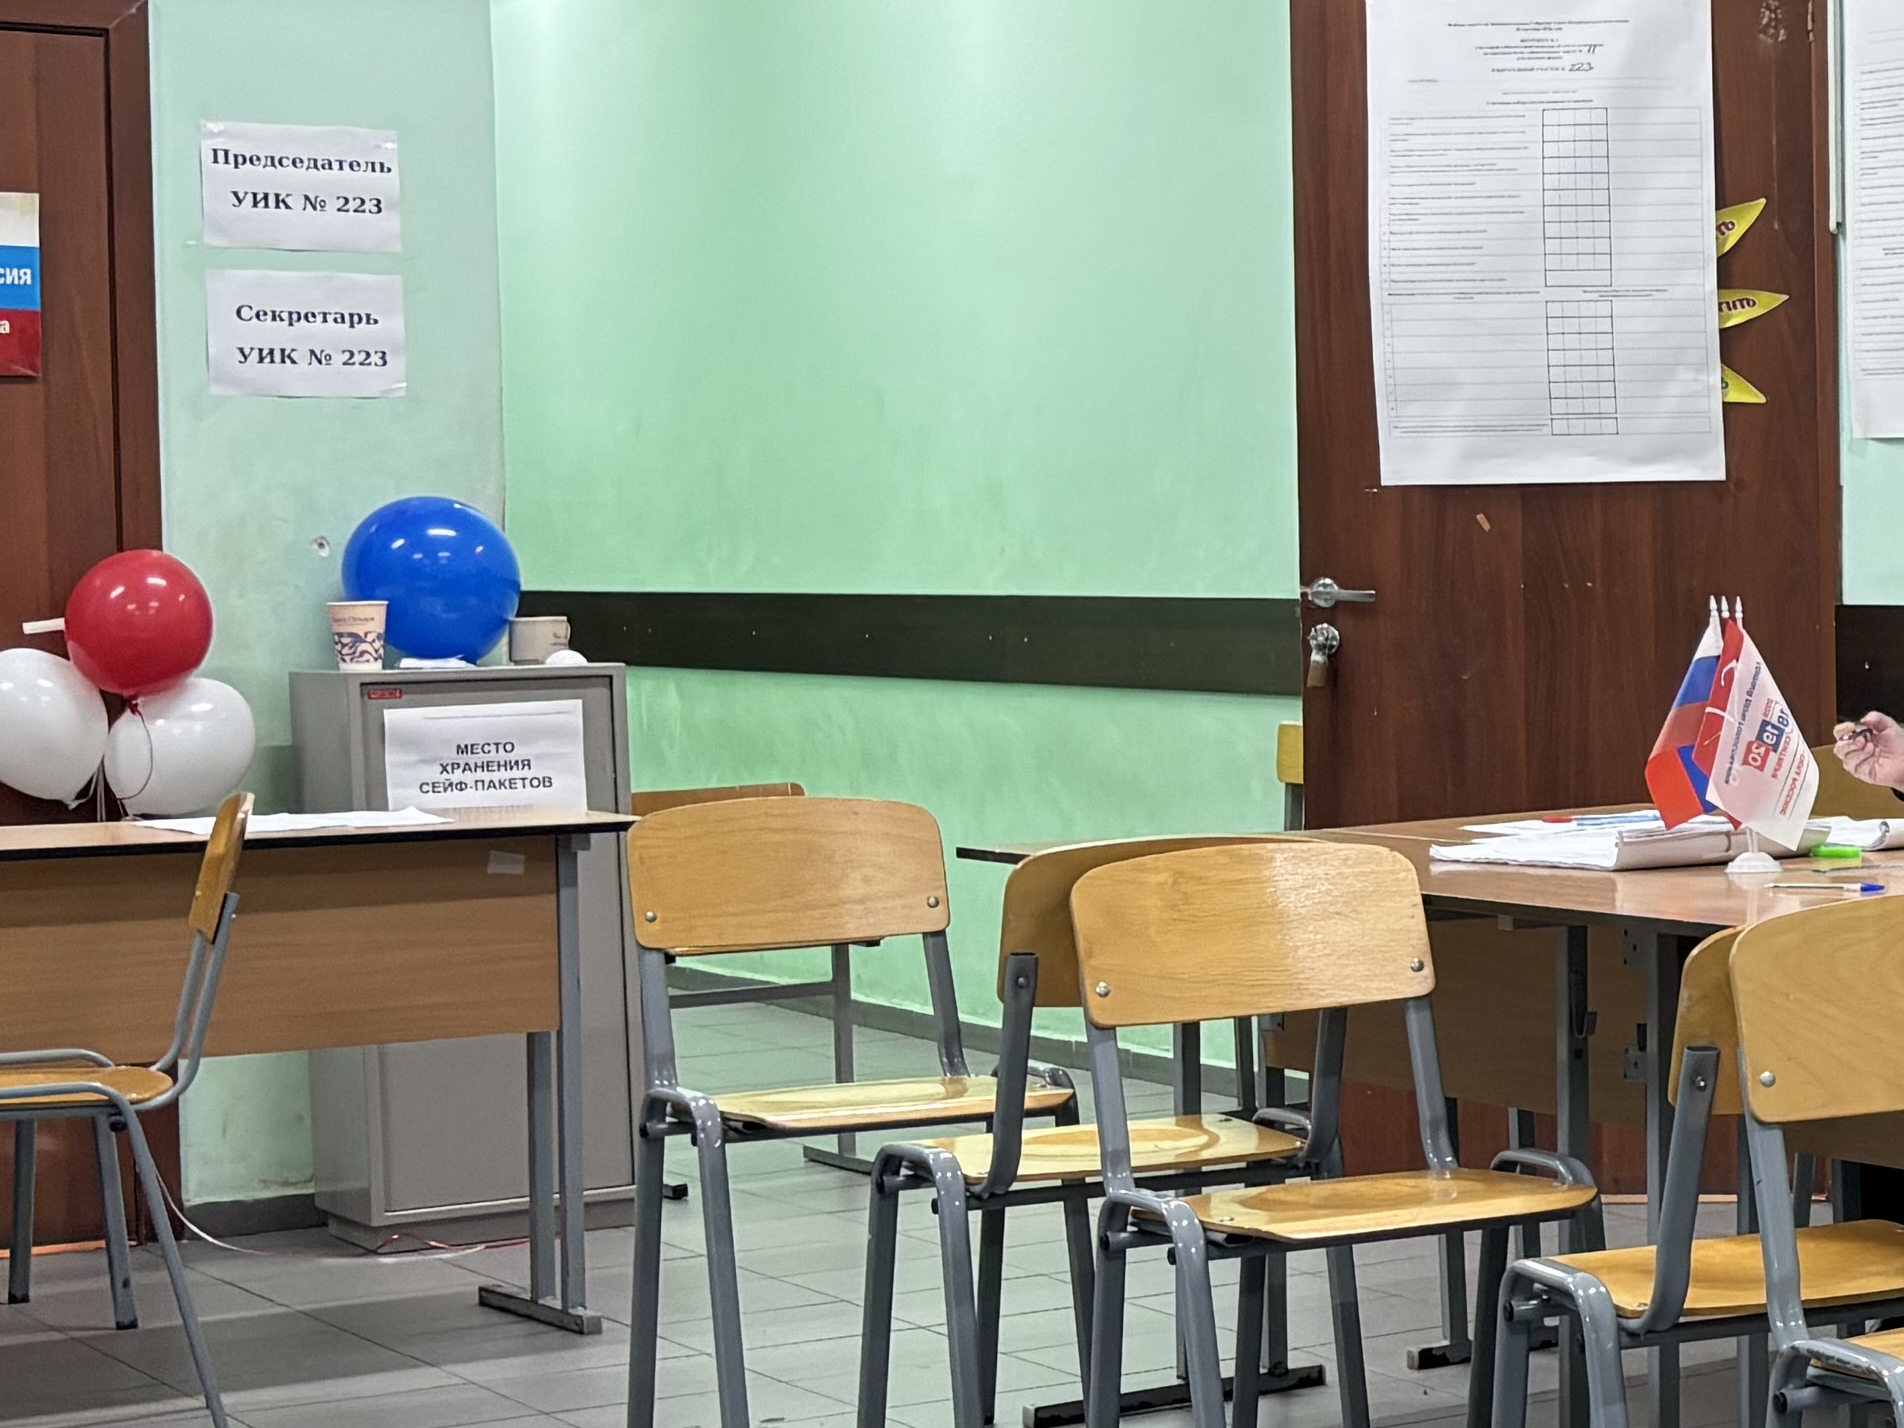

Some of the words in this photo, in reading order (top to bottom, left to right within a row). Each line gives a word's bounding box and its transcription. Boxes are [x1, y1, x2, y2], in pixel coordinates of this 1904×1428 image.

[211, 147, 393, 174] Председатель
[231, 190, 294, 211] УИК
[302, 193, 328, 212] №
[336, 196, 383, 215] 223
[236, 304, 379, 328] Секретарь
[236, 347, 299, 365] УИК
[307, 349, 332, 366] №
[342, 349, 388, 367] 223
[456, 741, 515, 755] МЕСТО
[439, 758, 532, 775] ХРАНЕНИЯ
[419, 776, 553, 794] СЕЙФ-ПАКЕТОВ
